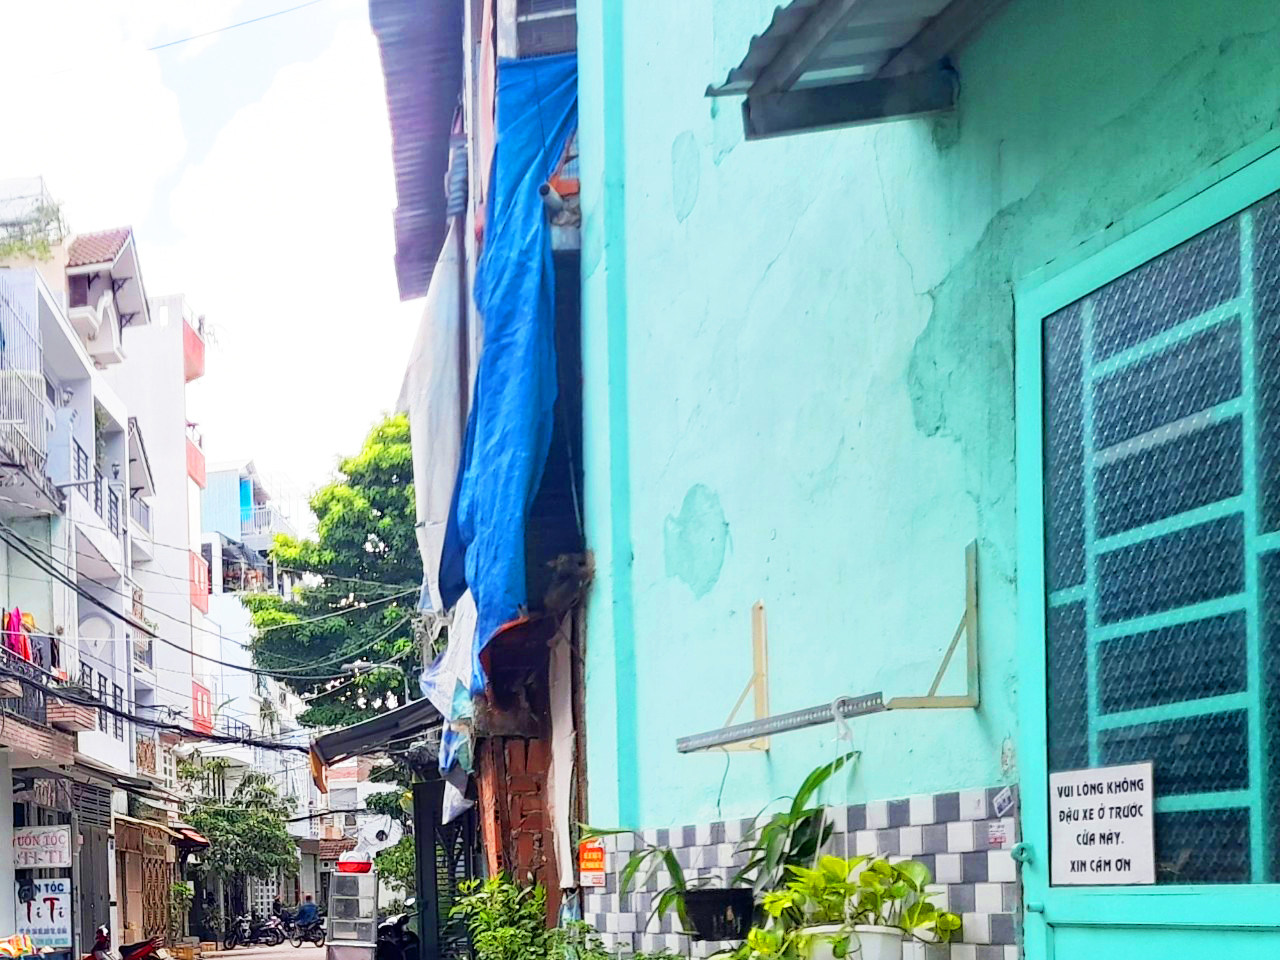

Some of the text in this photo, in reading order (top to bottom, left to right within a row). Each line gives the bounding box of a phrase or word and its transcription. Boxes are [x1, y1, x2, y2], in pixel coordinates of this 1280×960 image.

[1057, 777, 1144, 798] VUI LÒNG KHÔNG
[1058, 802, 1144, 825] ĐẬU XE Ở TRƯỚC
[17, 831, 66, 847] UỐN TÓC
[1076, 829, 1096, 846] CỬA
[1070, 860, 1087, 873] XIN
[1115, 858, 1131, 872] ƠN
[43, 881, 65, 893] TÓC
